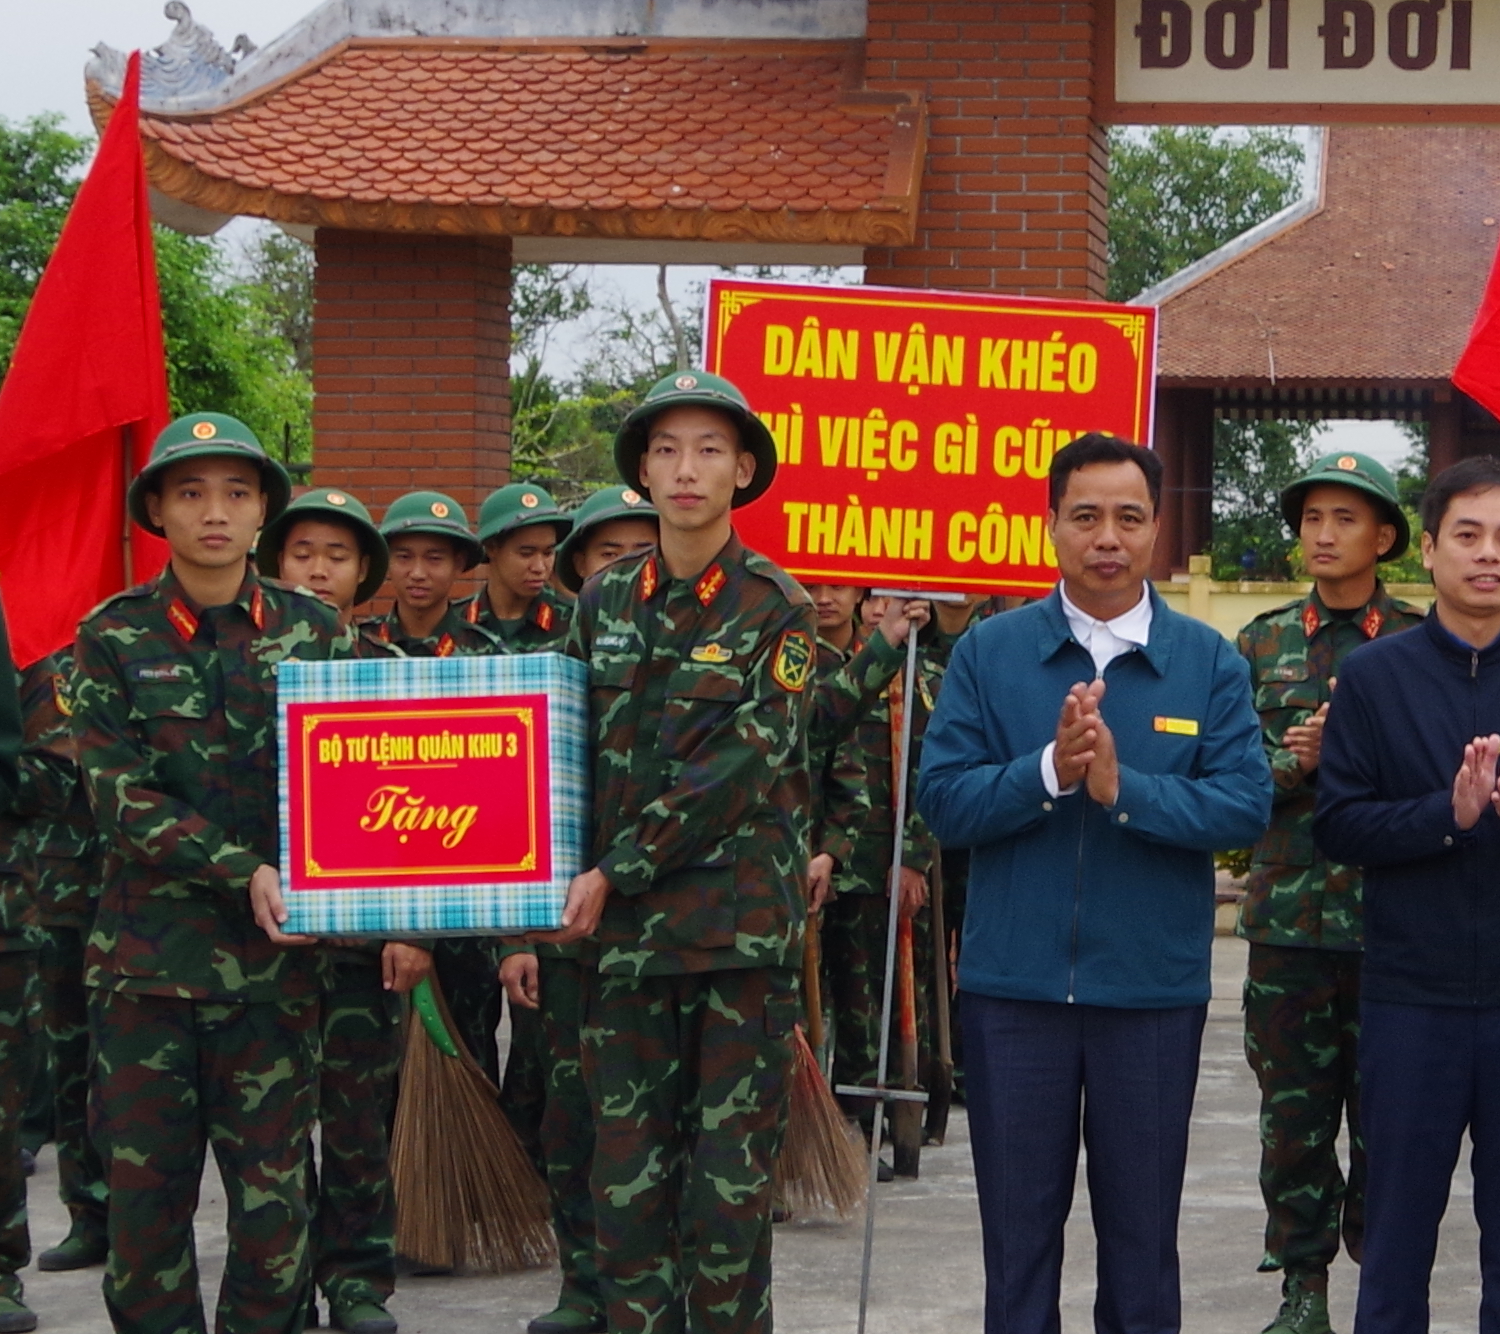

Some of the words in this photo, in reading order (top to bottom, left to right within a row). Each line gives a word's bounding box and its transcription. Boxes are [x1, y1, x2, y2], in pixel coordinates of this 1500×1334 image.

[763, 315, 860, 381] DÂN
[873, 322, 966, 396] VẬN
[978, 330, 1098, 394] KHÉO
[753, 402, 804, 465] HÌ
[817, 407, 919, 481] VIỆC
[933, 413, 979, 475] GÌ
[992, 417, 1115, 480] CŨ
[782, 494, 934, 561] THÀNH
[318, 733, 343, 767] BỘ
[345, 735, 370, 762] TƯ
[370, 732, 415, 766] LỆNH
[417, 730, 465, 762] QUÂN
[467, 733, 503, 759] KHU
[505, 732, 518, 758] 3
[359, 785, 478, 848] Tặng
